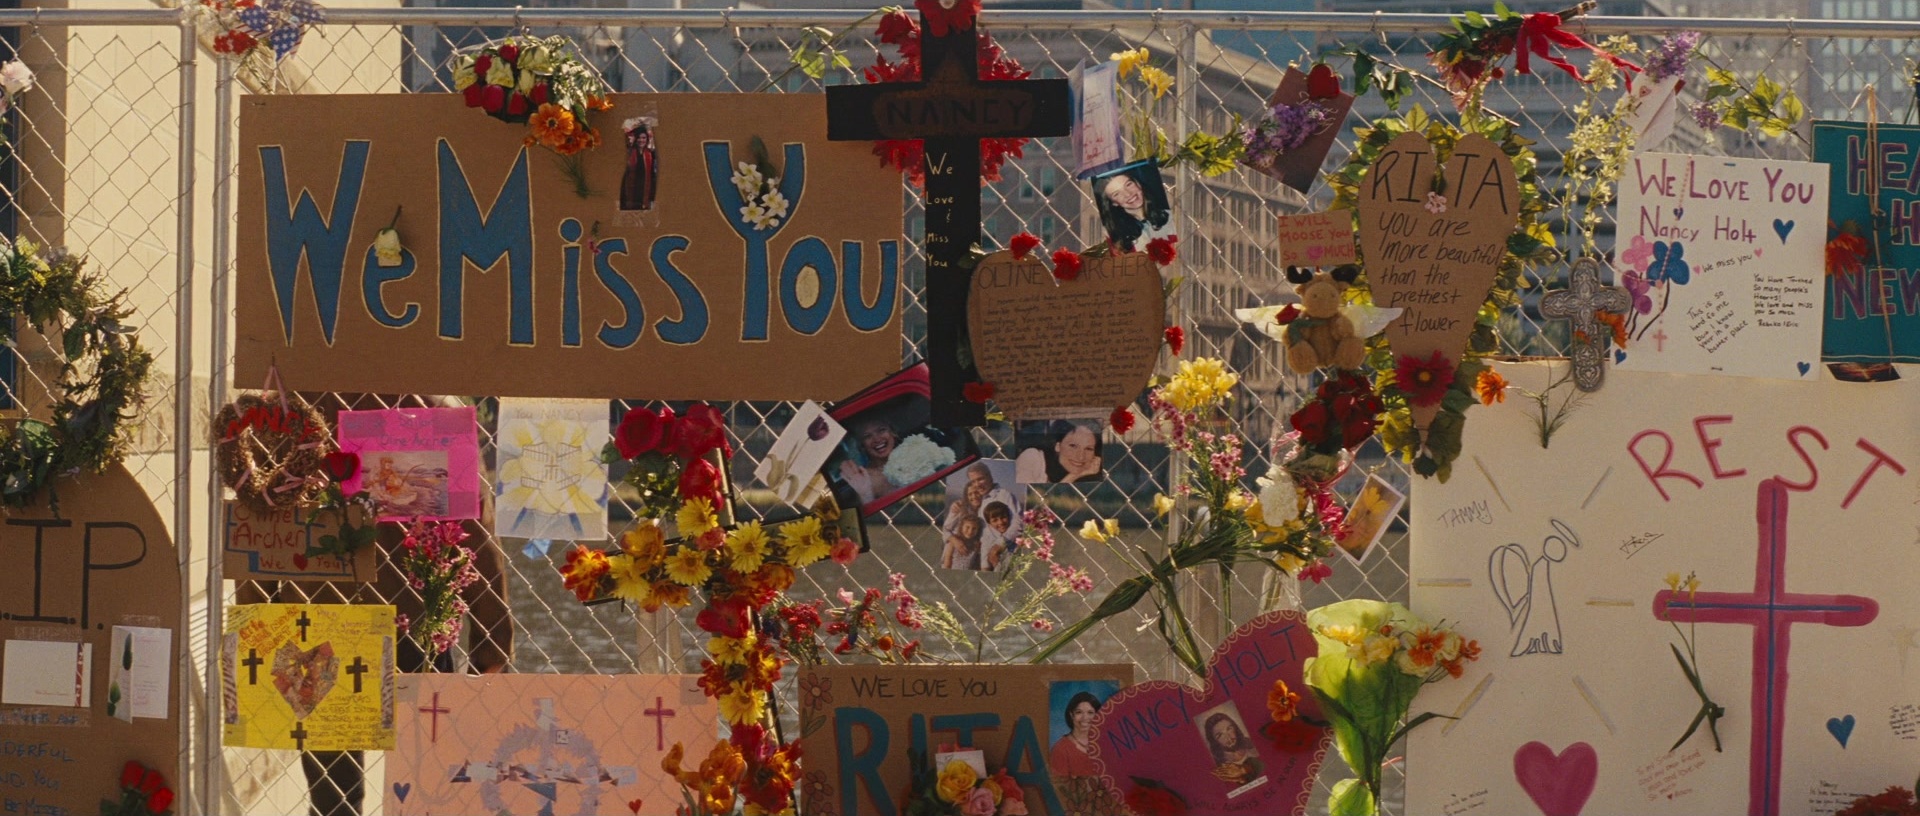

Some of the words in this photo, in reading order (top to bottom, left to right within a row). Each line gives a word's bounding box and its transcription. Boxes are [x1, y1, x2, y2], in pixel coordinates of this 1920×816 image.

[887, 95, 1029, 127] NANCY
[926, 152, 953, 174] We
[1371, 150, 1508, 215] RITA
[1689, 160, 1749, 200] LOVE
[926, 195, 953, 204] Love
[1279, 216, 1289, 227] I
[1292, 215, 1332, 227] WILL
[1428, 218, 1471, 237] are
[1640, 205, 1699, 242] Nancy
[1714, 215, 1757, 243] Holt
[258, 139, 420, 347] We
[437, 137, 710, 350] Miss
[702, 140, 899, 342] You
[927, 233, 949, 243] Miss
[1280, 229, 1324, 243] MOOSE
[926, 254, 948, 268] You
[1323, 243, 1355, 258] MUCH
[1381, 241, 1428, 262] more
[1435, 243, 1500, 266] beautiful
[977, 261, 1045, 289] OLINE
[1076, 254, 1150, 280] ARCHER
[1380, 266, 1416, 284] than
[1424, 263, 1450, 284] the
[1702, 264, 1713, 273] We
[1716, 259, 1735, 268] miss
[1737, 254, 1752, 266] you
[1753, 273, 1764, 282] You
[1390, 288, 1461, 308] prettiest
[1687, 306, 1704, 320] This
[1714, 291, 1724, 299] so
[1716, 301, 1729, 311] me
[1399, 307, 1460, 336] flower
[1716, 310, 1734, 325] know
[1730, 320, 1748, 337] place
[1627, 415, 1906, 509] REST
[1437, 499, 1493, 529] TAMMY
[233, 522, 305, 549] Archer
[260, 557, 285, 570] We
[851, 676, 895, 698] WE
[901, 678, 949, 698] LOVE
[959, 678, 997, 698] YOU
[1107, 686, 1191, 758] NANCY
[1212, 624, 1296, 697] HOLT
[0, 741, 73, 763] DERFUL
[833, 706, 1065, 816] RITA
